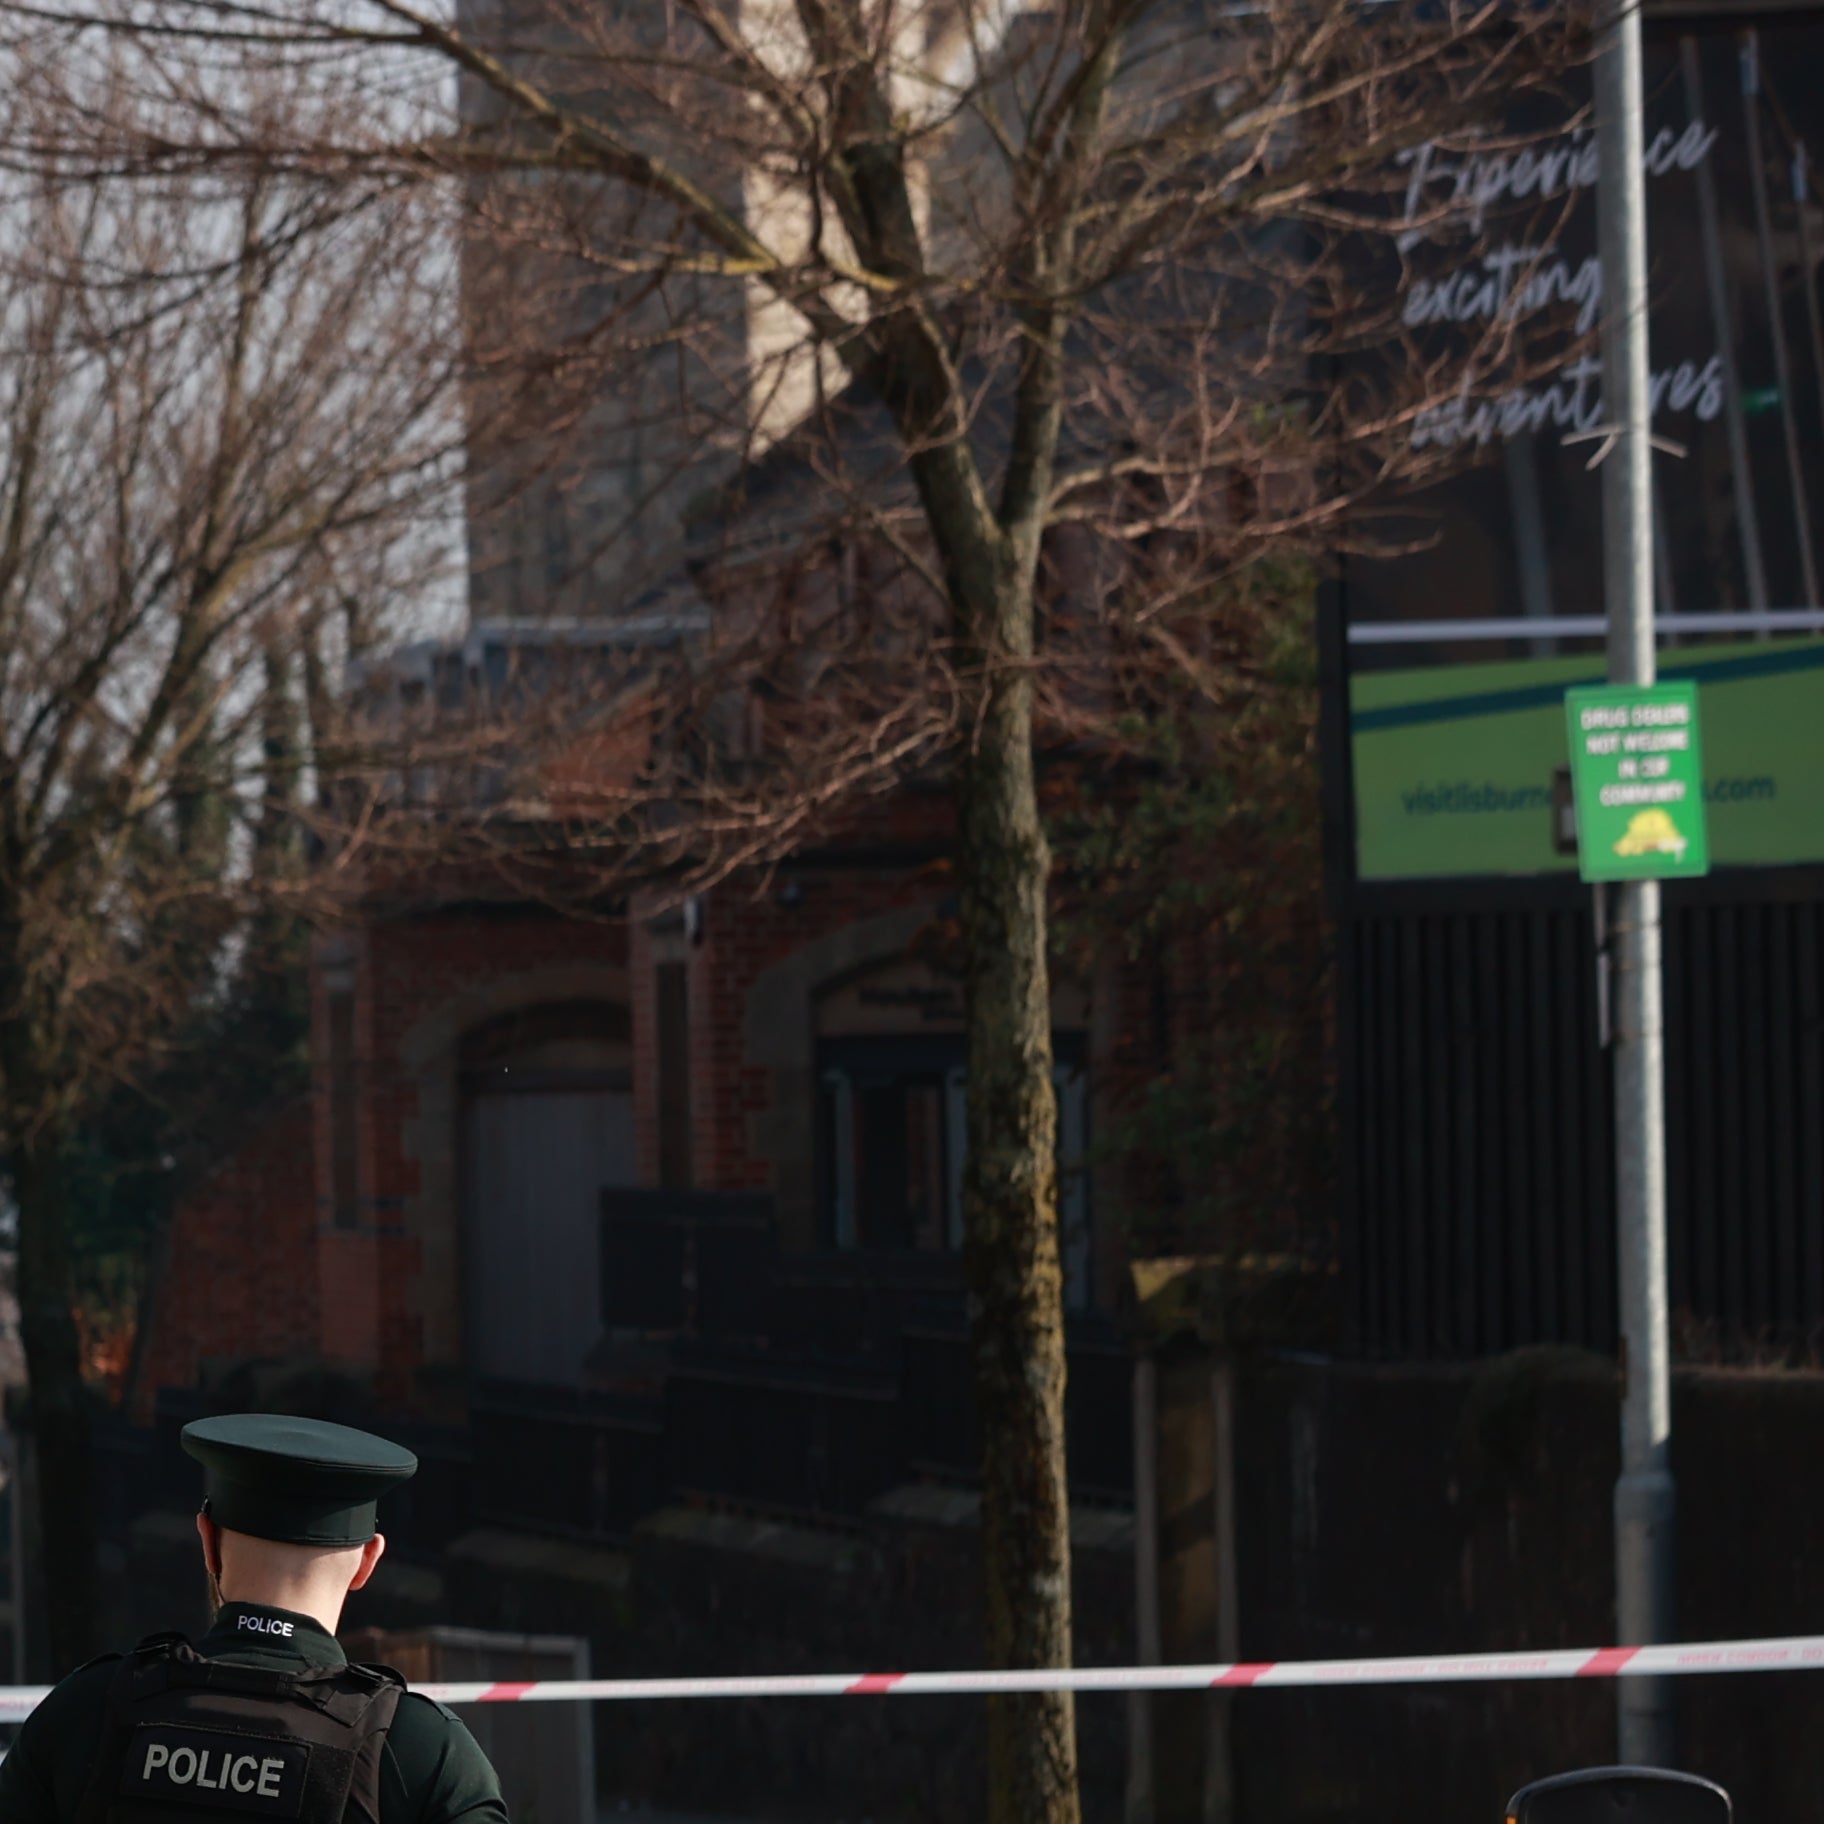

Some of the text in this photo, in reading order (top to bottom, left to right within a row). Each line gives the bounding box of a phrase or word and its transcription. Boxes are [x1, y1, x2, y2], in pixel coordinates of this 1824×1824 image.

[1395, 118, 1719, 253] Experiece
[1410, 352, 1724, 450] adventres
[237, 1615, 295, 1637] POLICE
[142, 1743, 285, 1797] POLICE
